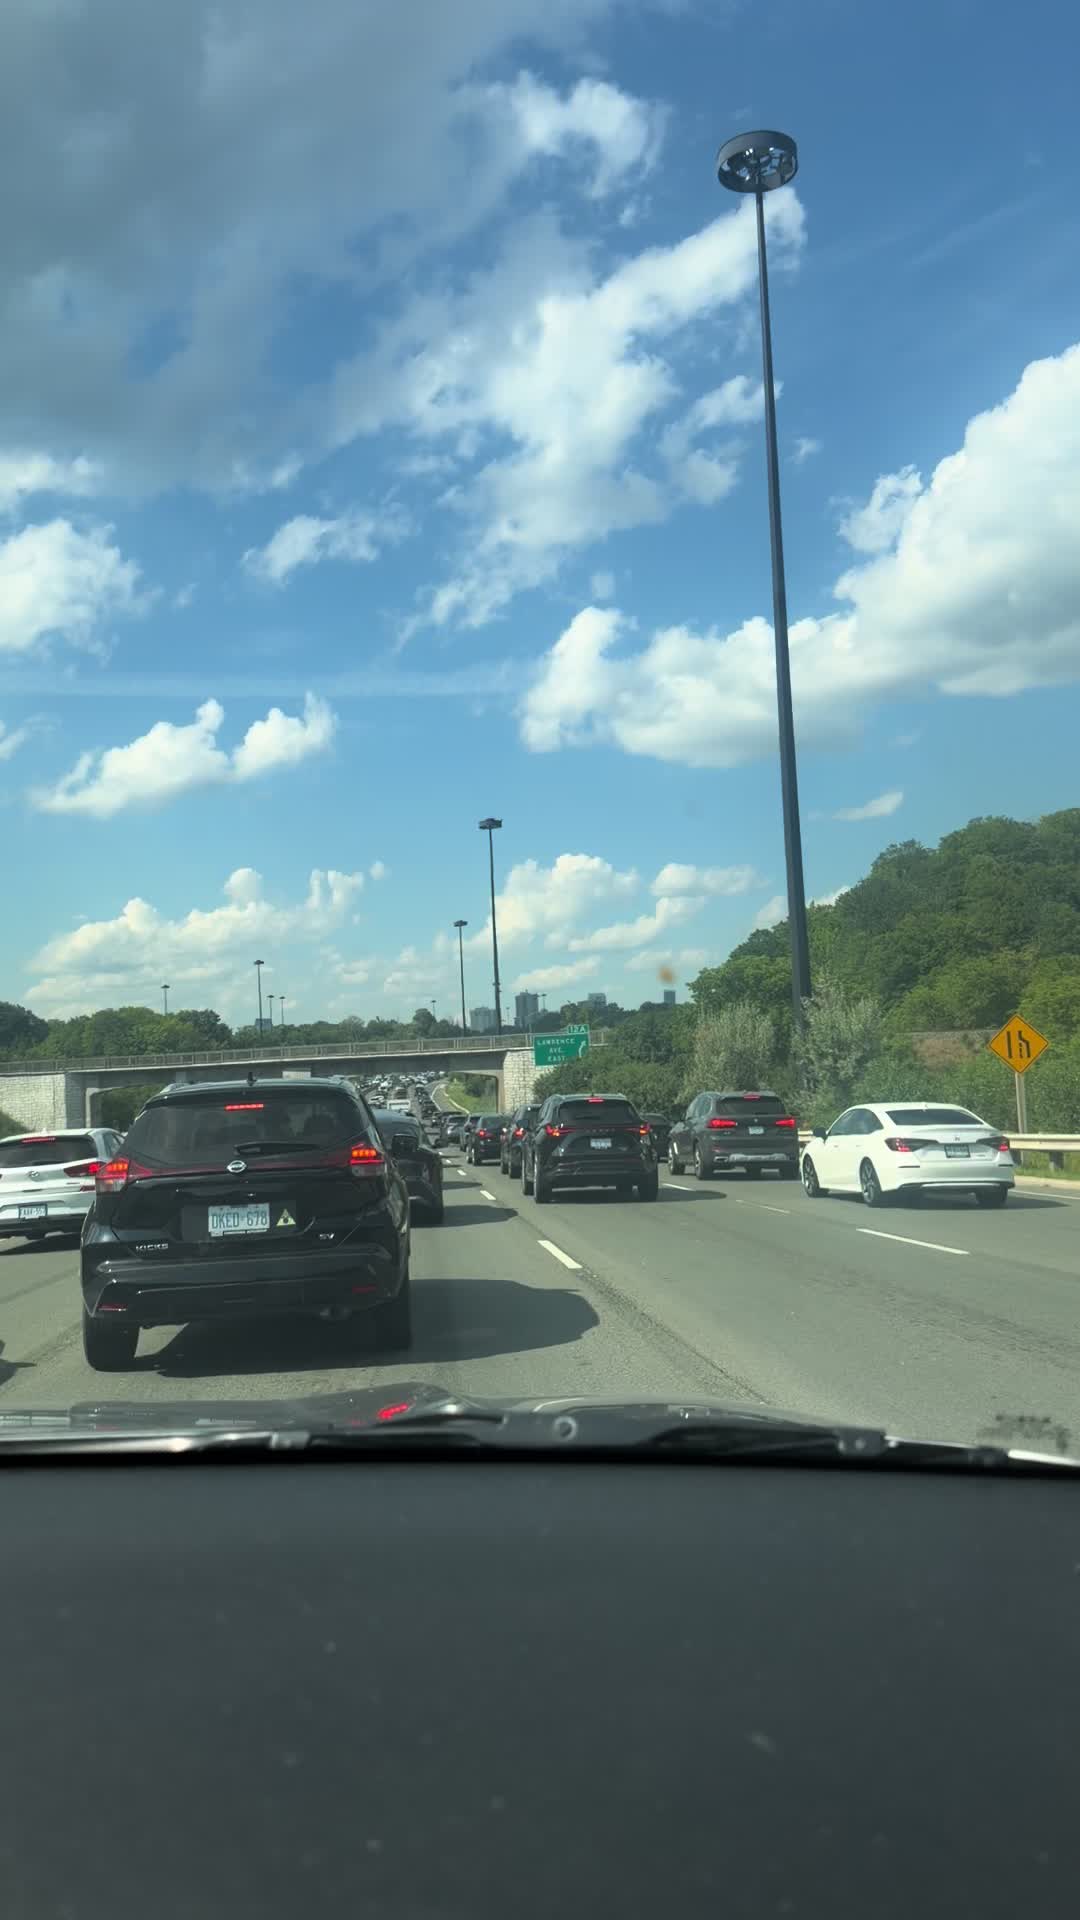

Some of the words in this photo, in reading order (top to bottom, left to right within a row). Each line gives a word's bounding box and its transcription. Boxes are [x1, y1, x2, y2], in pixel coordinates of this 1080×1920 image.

[536, 1038, 576, 1046] LAWRENCE
[211, 1211, 240, 1229] DKED
[246, 1210, 268, 1227] 678
[319, 1232, 335, 1240] SV
[135, 1242, 169, 1251] KICKS
